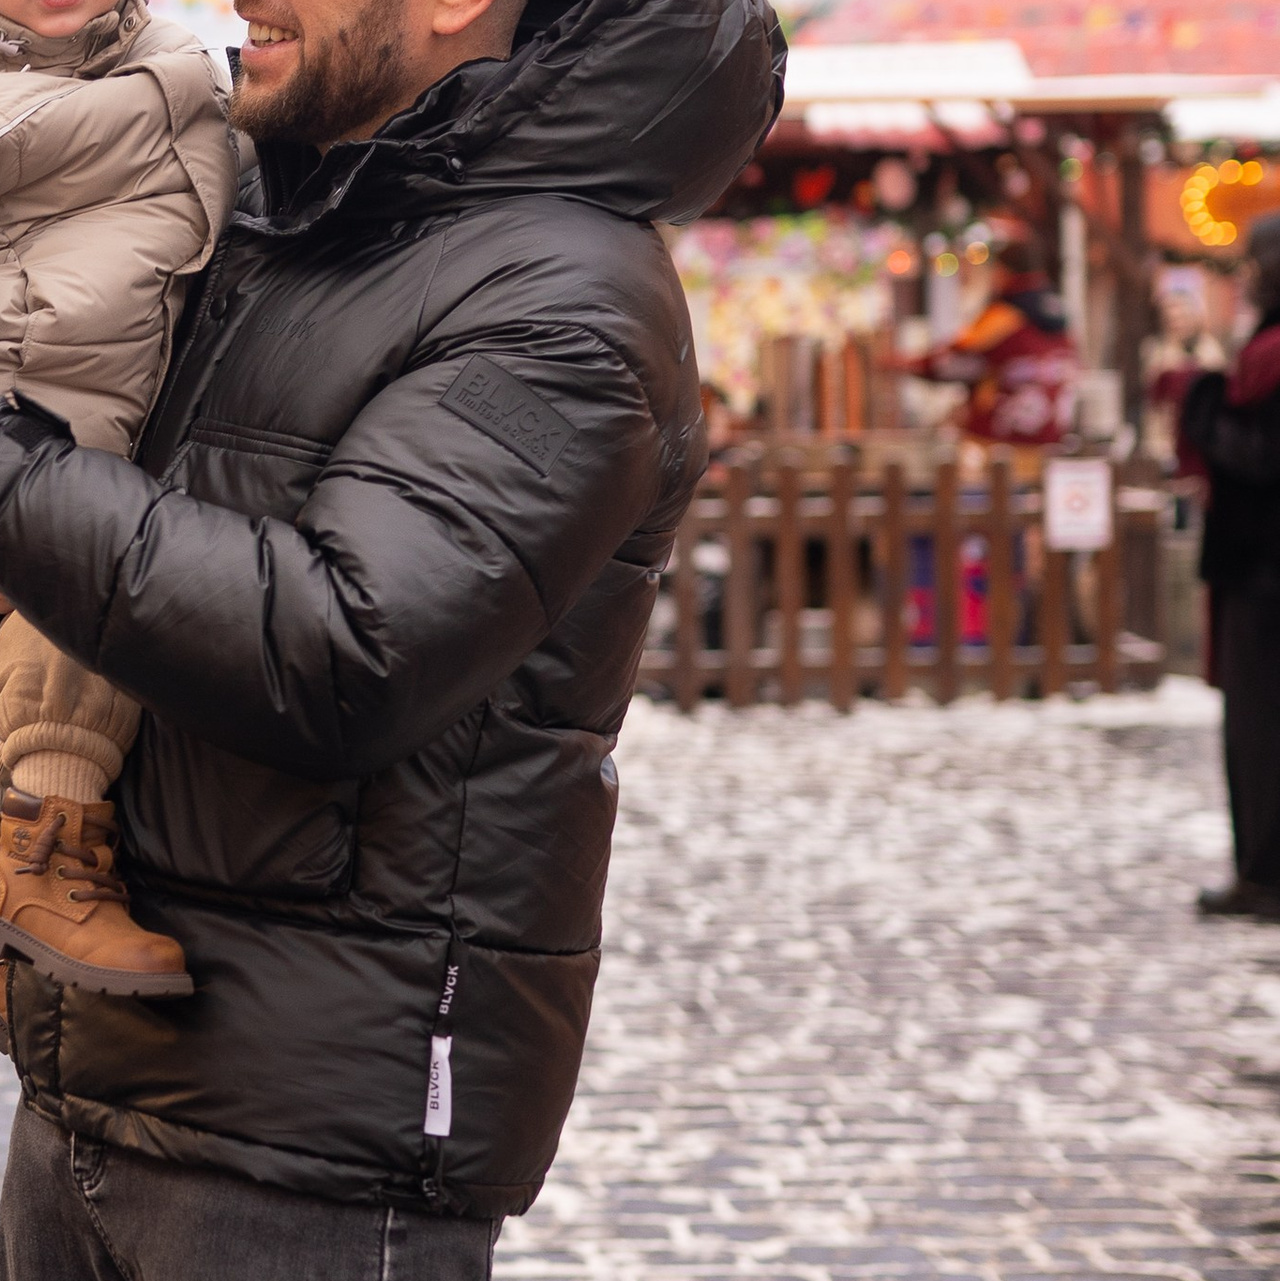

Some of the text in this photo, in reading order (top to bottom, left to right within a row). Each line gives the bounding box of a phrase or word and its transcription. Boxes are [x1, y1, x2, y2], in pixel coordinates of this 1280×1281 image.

[255, 316, 317, 340] BLVCK
[454, 390, 545, 461] limited edition
[462, 372, 562, 453] BLVCK
[439, 965, 459, 1014] BLVCK
[430, 1060, 439, 1111] BLVCK
